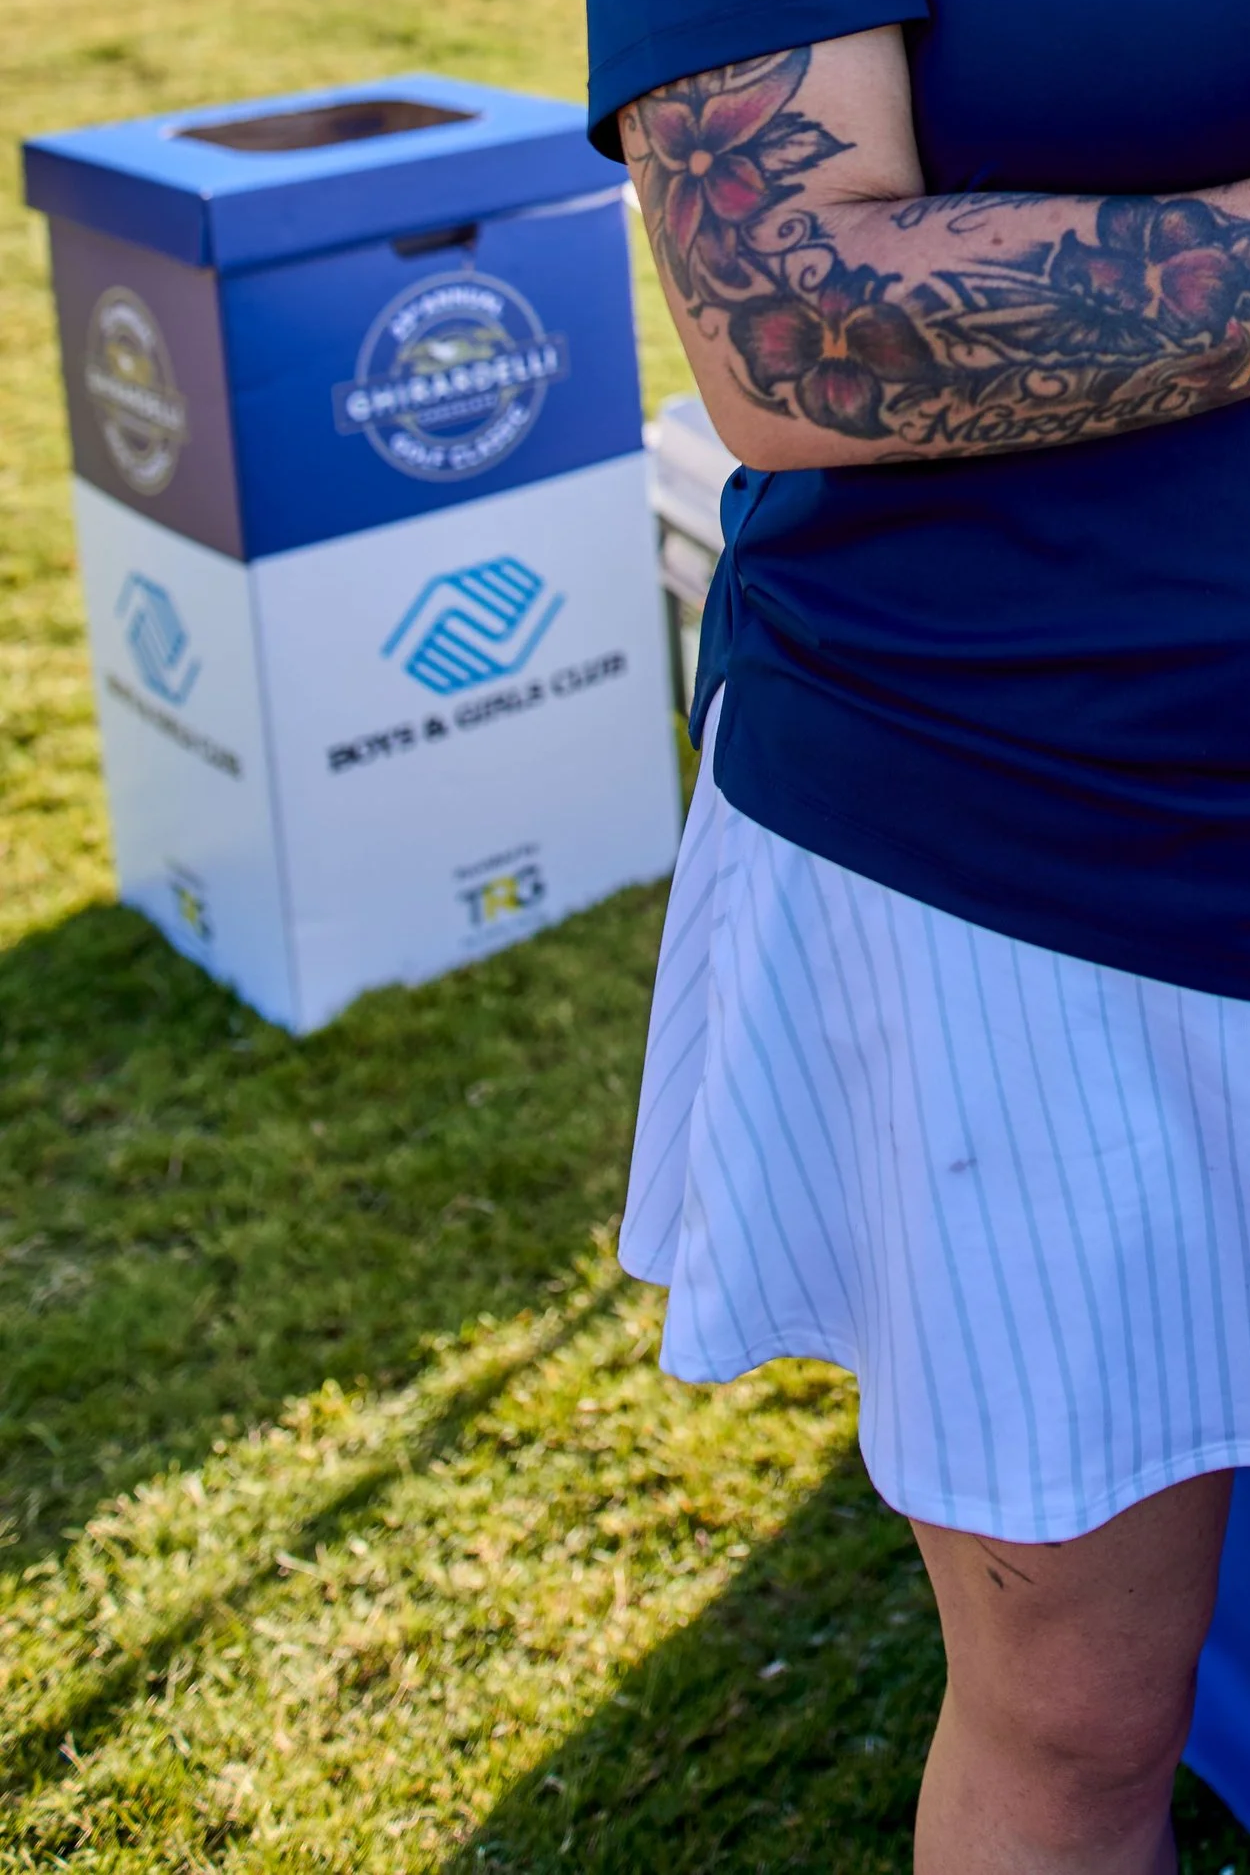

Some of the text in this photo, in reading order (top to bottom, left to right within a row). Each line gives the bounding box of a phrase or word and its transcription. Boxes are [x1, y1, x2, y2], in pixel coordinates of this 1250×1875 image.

[346, 344, 558, 422] GHIRARDELLI
[328, 721, 416, 774] BOYS
[423, 711, 449, 743] &
[550, 649, 627, 697] CLUB
